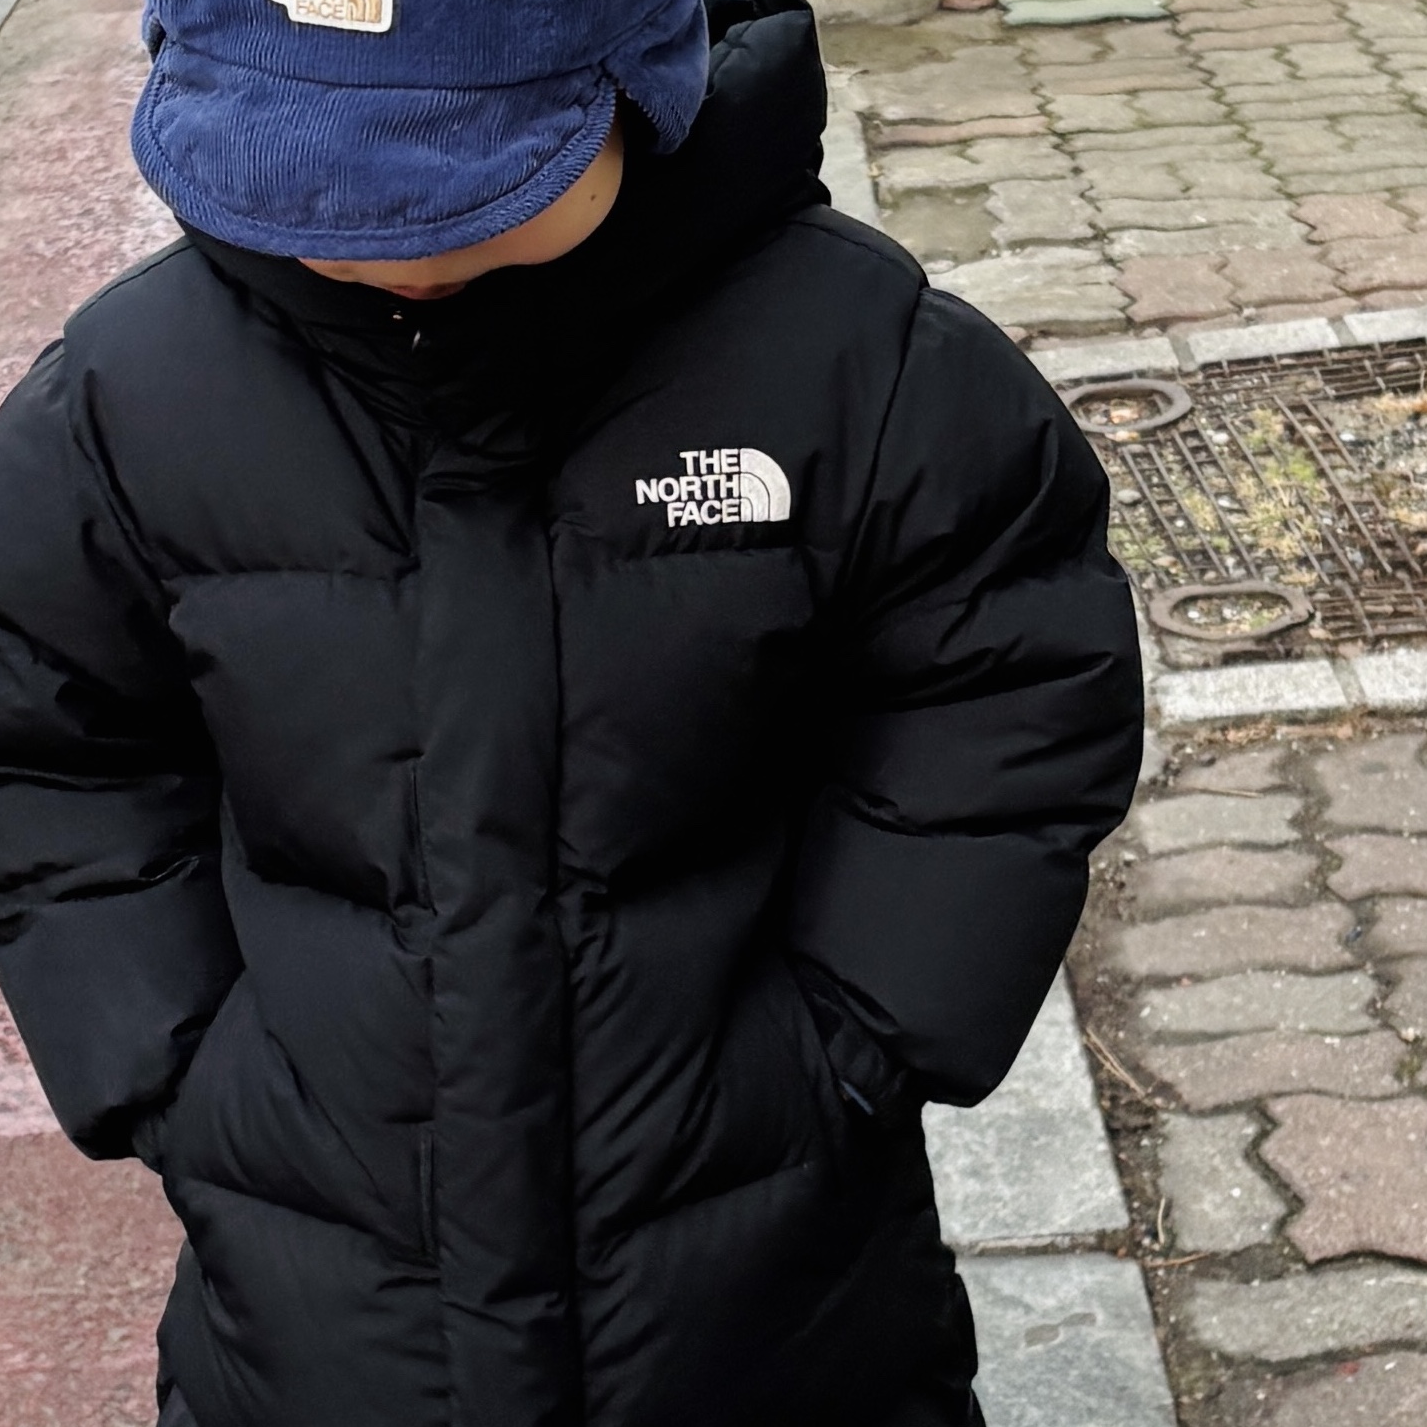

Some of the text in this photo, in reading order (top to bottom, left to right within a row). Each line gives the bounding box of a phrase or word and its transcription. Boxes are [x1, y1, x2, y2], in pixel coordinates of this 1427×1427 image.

[295, 0, 345, 20] FACE
[679, 448, 740, 474] THE
[635, 473, 739, 505] NORTH
[667, 498, 740, 527] FACE
